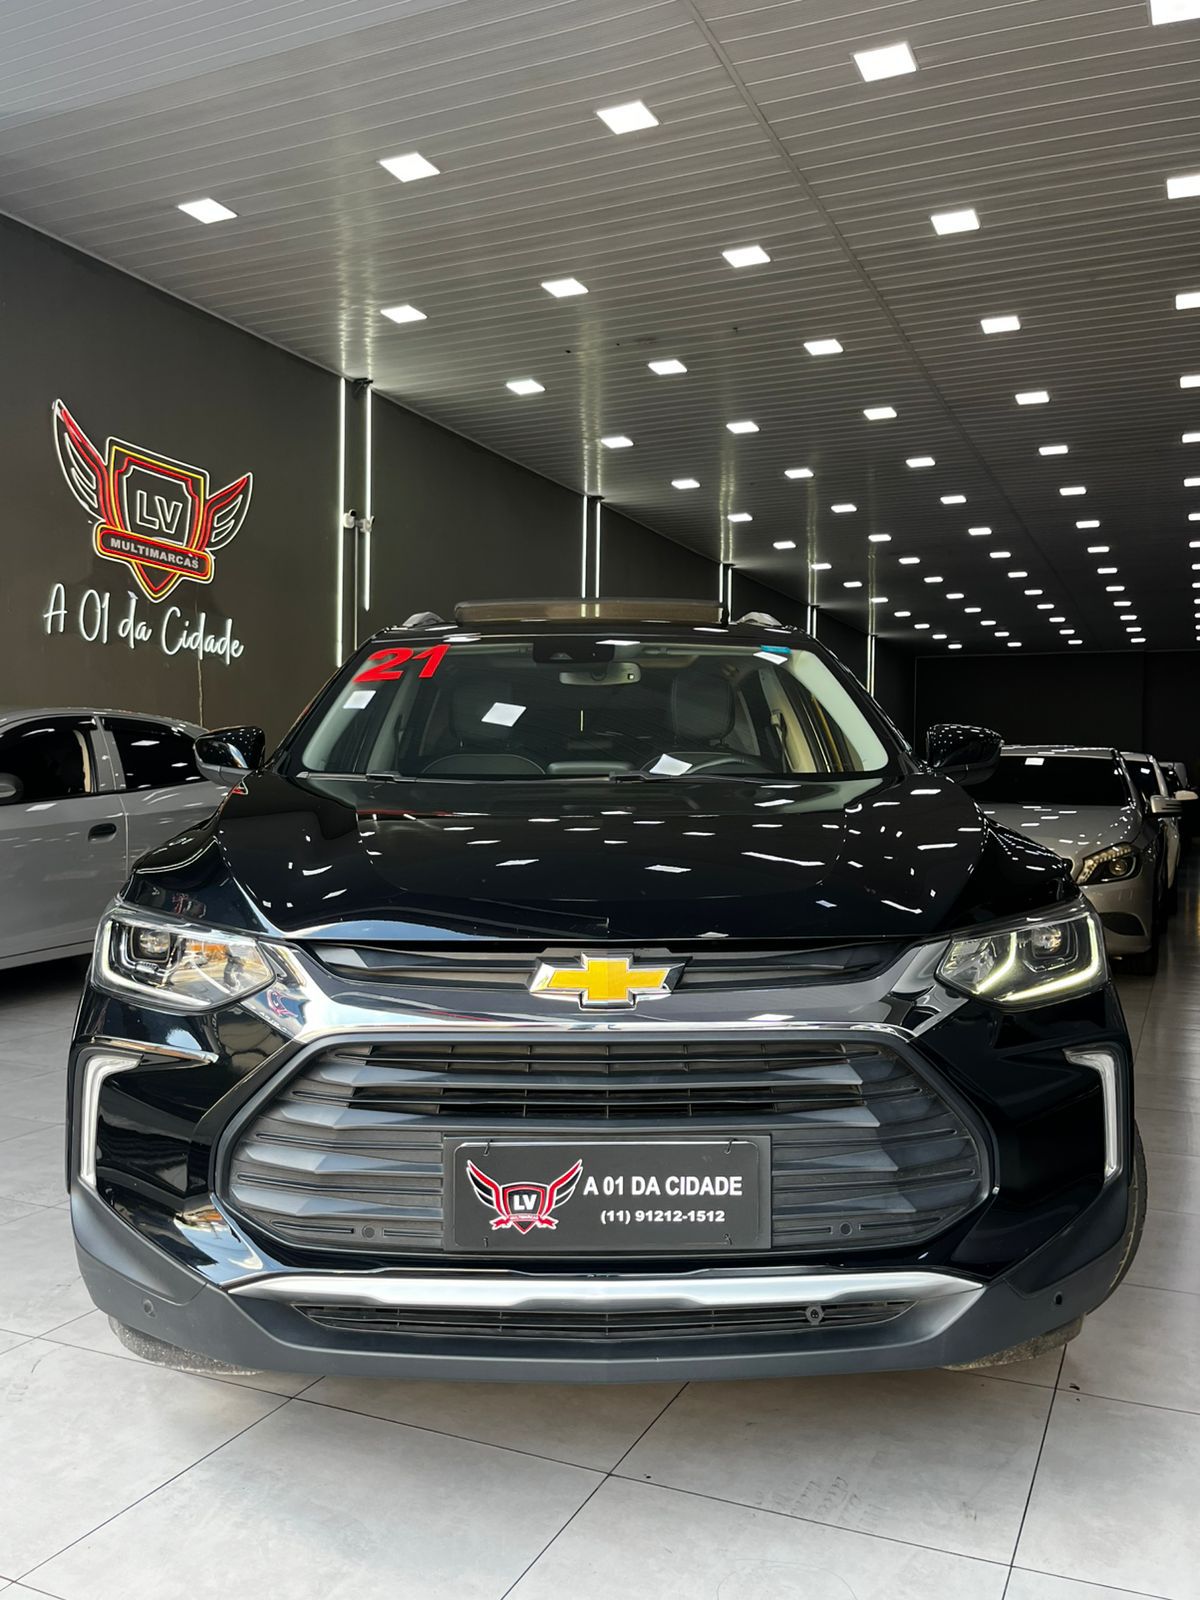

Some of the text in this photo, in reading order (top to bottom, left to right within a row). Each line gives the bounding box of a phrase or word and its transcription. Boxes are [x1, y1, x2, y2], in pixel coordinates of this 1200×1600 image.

[136, 490, 182, 534] LV
[110, 537, 199, 569] MULTIMARCAS
[43, 583, 244, 665] A 01 da Cidade
[352, 644, 451, 683] 21
[582, 1175, 743, 1196] A 01 DA CIDADE
[513, 1194, 537, 1211] LV
[600, 1210, 725, 1225] (11) 91212-1512
